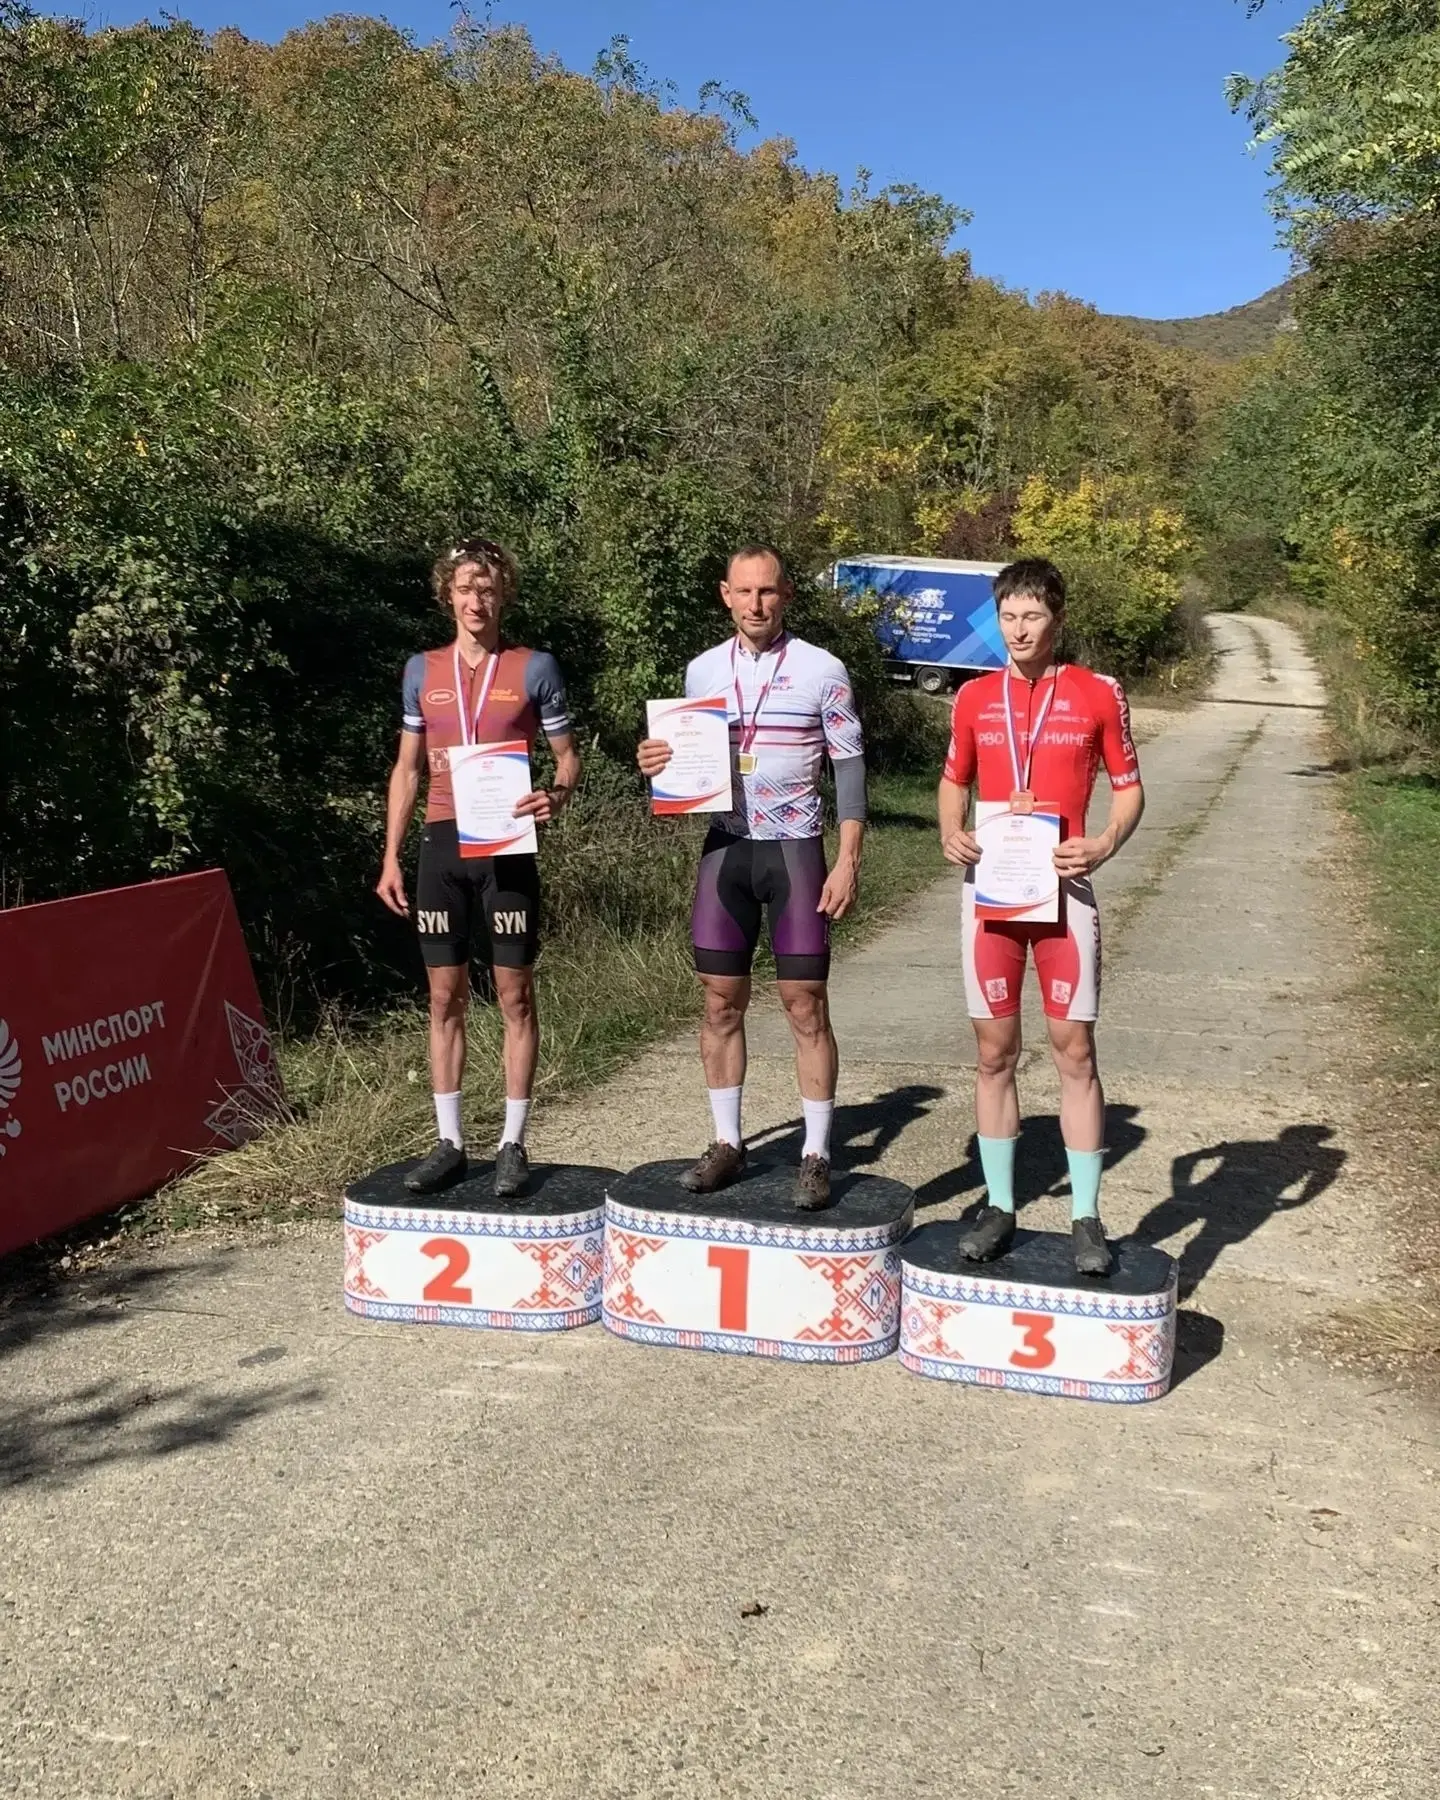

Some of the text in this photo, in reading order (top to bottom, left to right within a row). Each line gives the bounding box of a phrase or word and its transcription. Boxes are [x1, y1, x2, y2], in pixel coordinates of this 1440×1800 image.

[1113, 683, 1136, 762] GADGET
[417, 909, 450, 934] SYN
[494, 910, 527, 934] SYN
[41, 1000, 165, 1065] МИНСПОРТ
[54, 1053, 152, 1112] РОССИИ
[419, 1237, 473, 1305] 2
[707, 1245, 750, 1332] 1
[1008, 1311, 1057, 1369] 3
